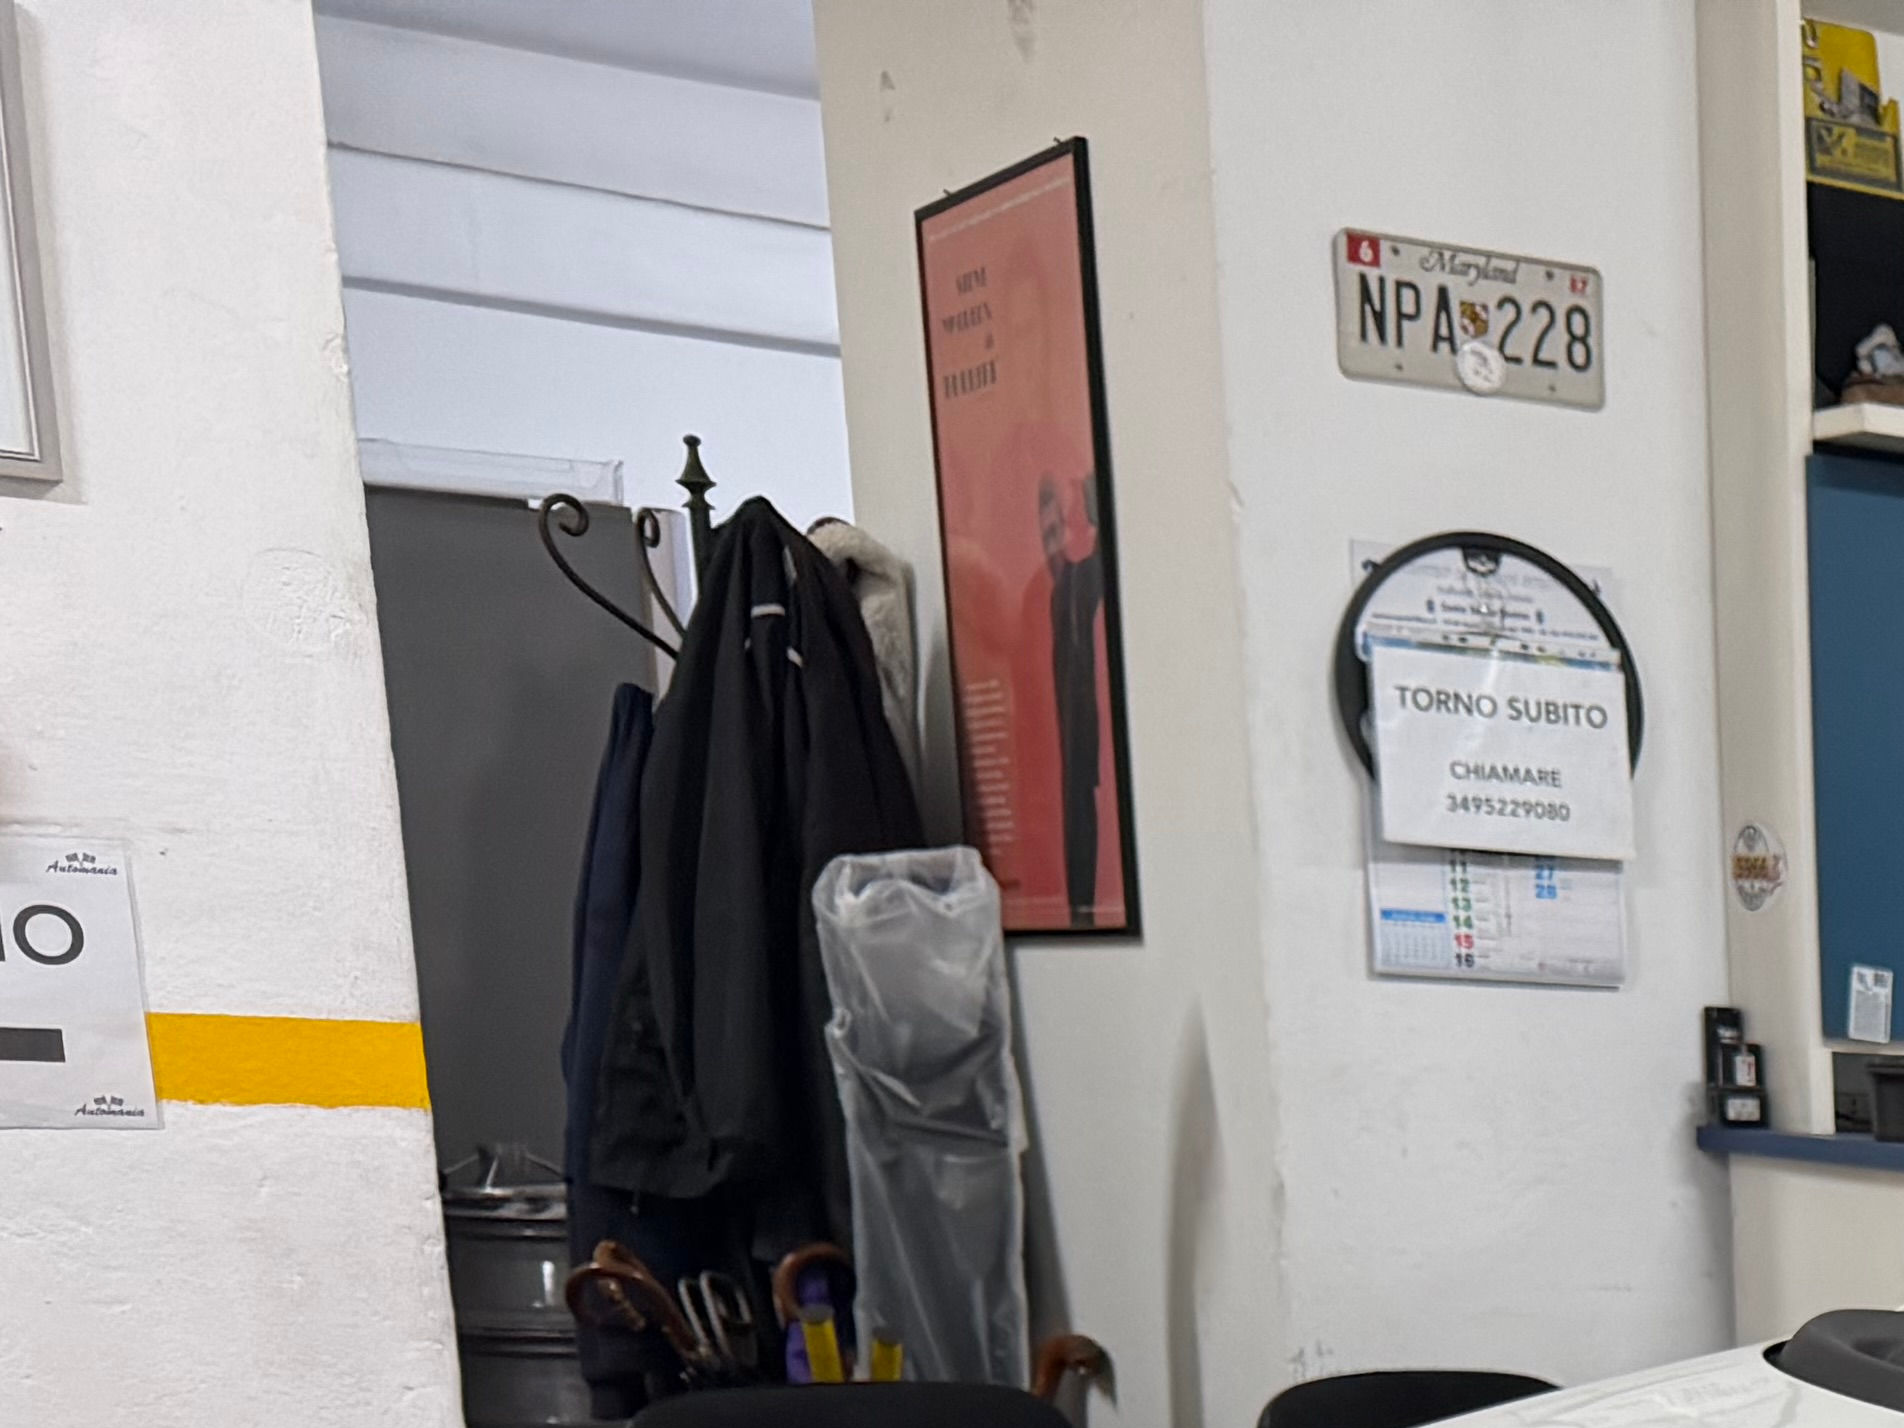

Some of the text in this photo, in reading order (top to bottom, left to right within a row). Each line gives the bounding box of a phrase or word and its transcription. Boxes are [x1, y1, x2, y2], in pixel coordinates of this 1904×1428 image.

[1419, 250, 1519, 286] Maryland
[1359, 273, 1592, 373] NPA 228
[1394, 685, 1608, 730] TORNO SUBITO
[1449, 760, 1563, 789] CHIAMARE
[45, 859, 118, 875] Automania
[74, 1103, 145, 1117] Automania
